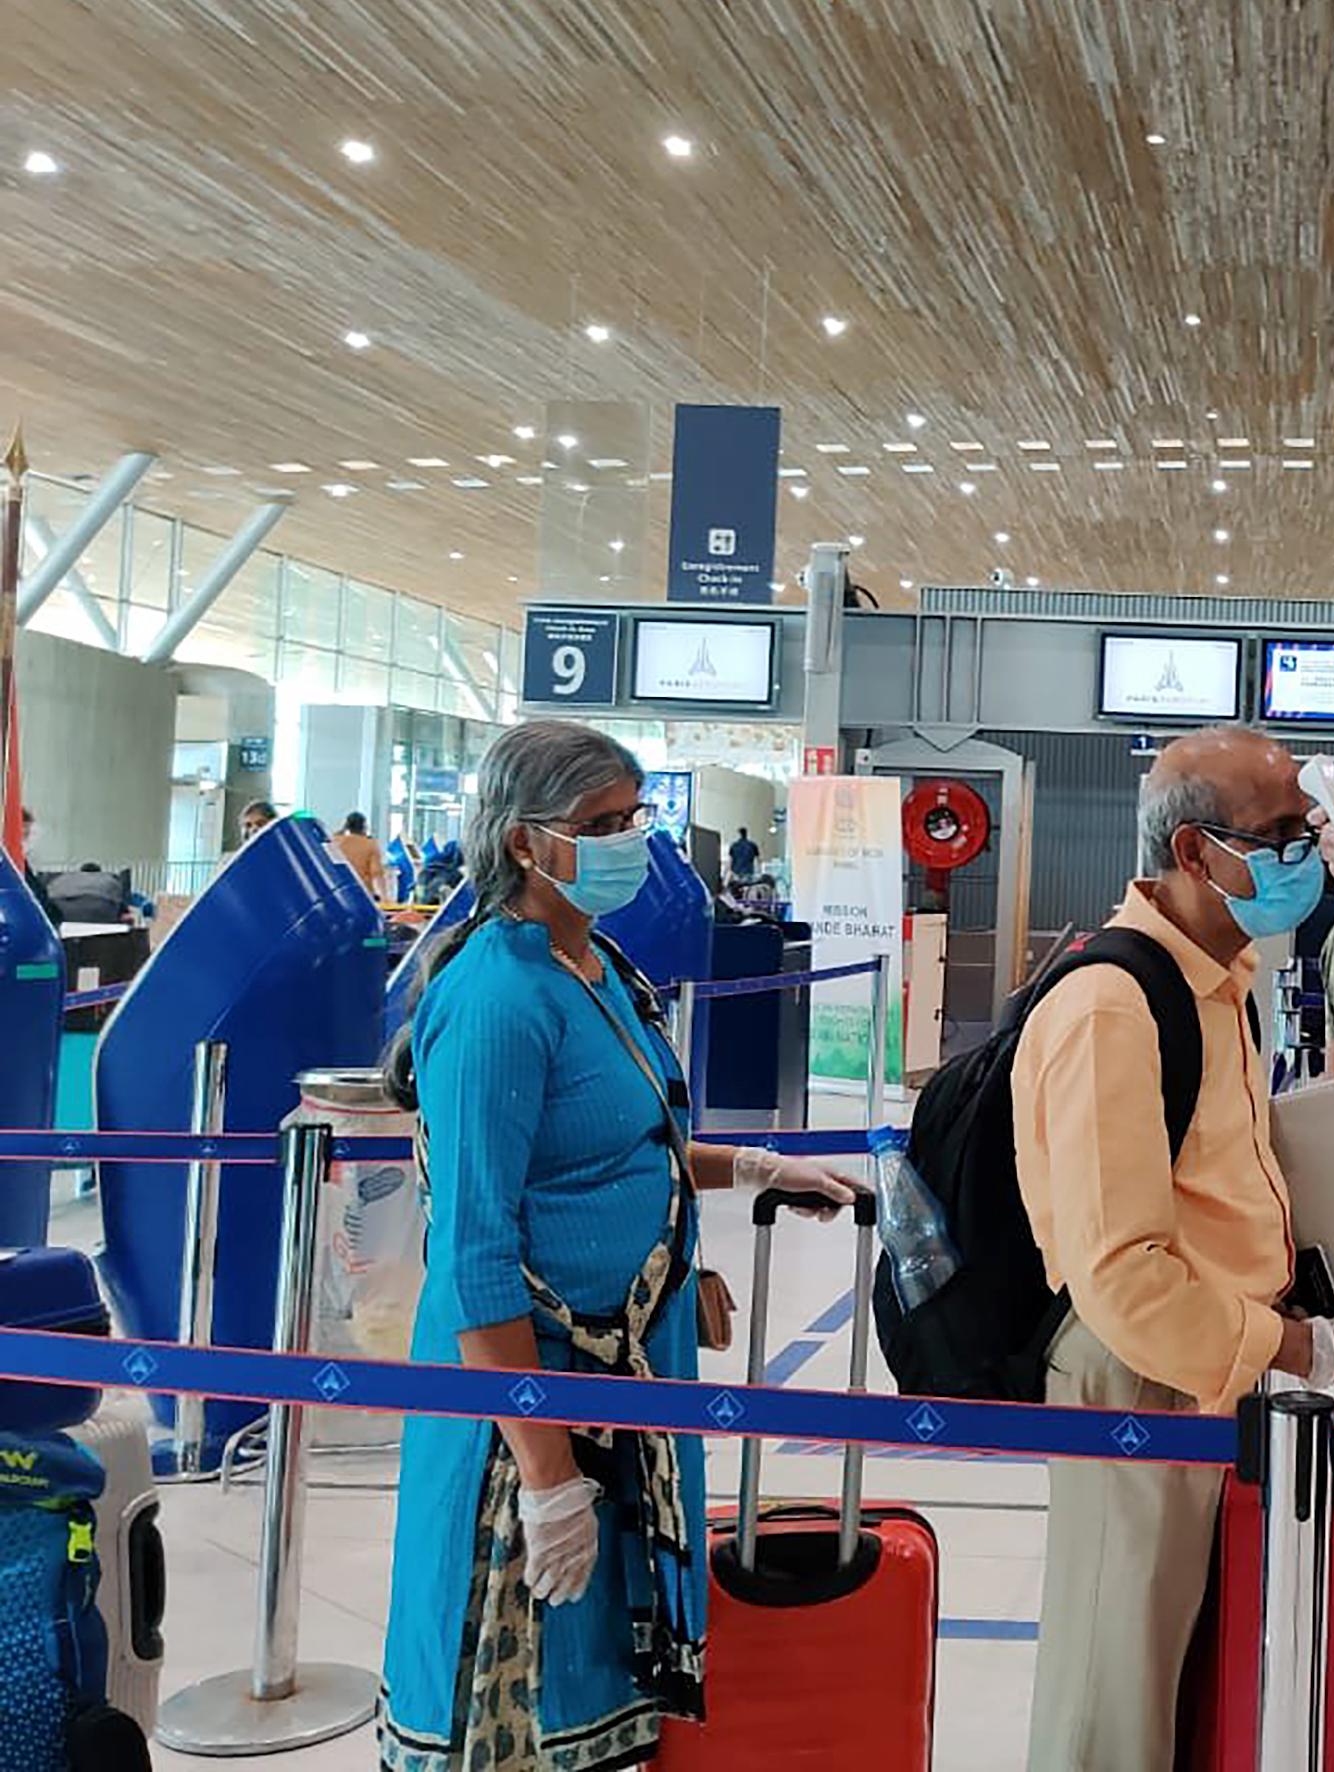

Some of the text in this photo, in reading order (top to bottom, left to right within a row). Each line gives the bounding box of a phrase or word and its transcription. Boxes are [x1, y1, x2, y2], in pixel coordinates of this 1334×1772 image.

[552, 645, 586, 695] 9
[823, 905, 867, 918] MISSION
[845, 922, 896, 938] BHARAT
